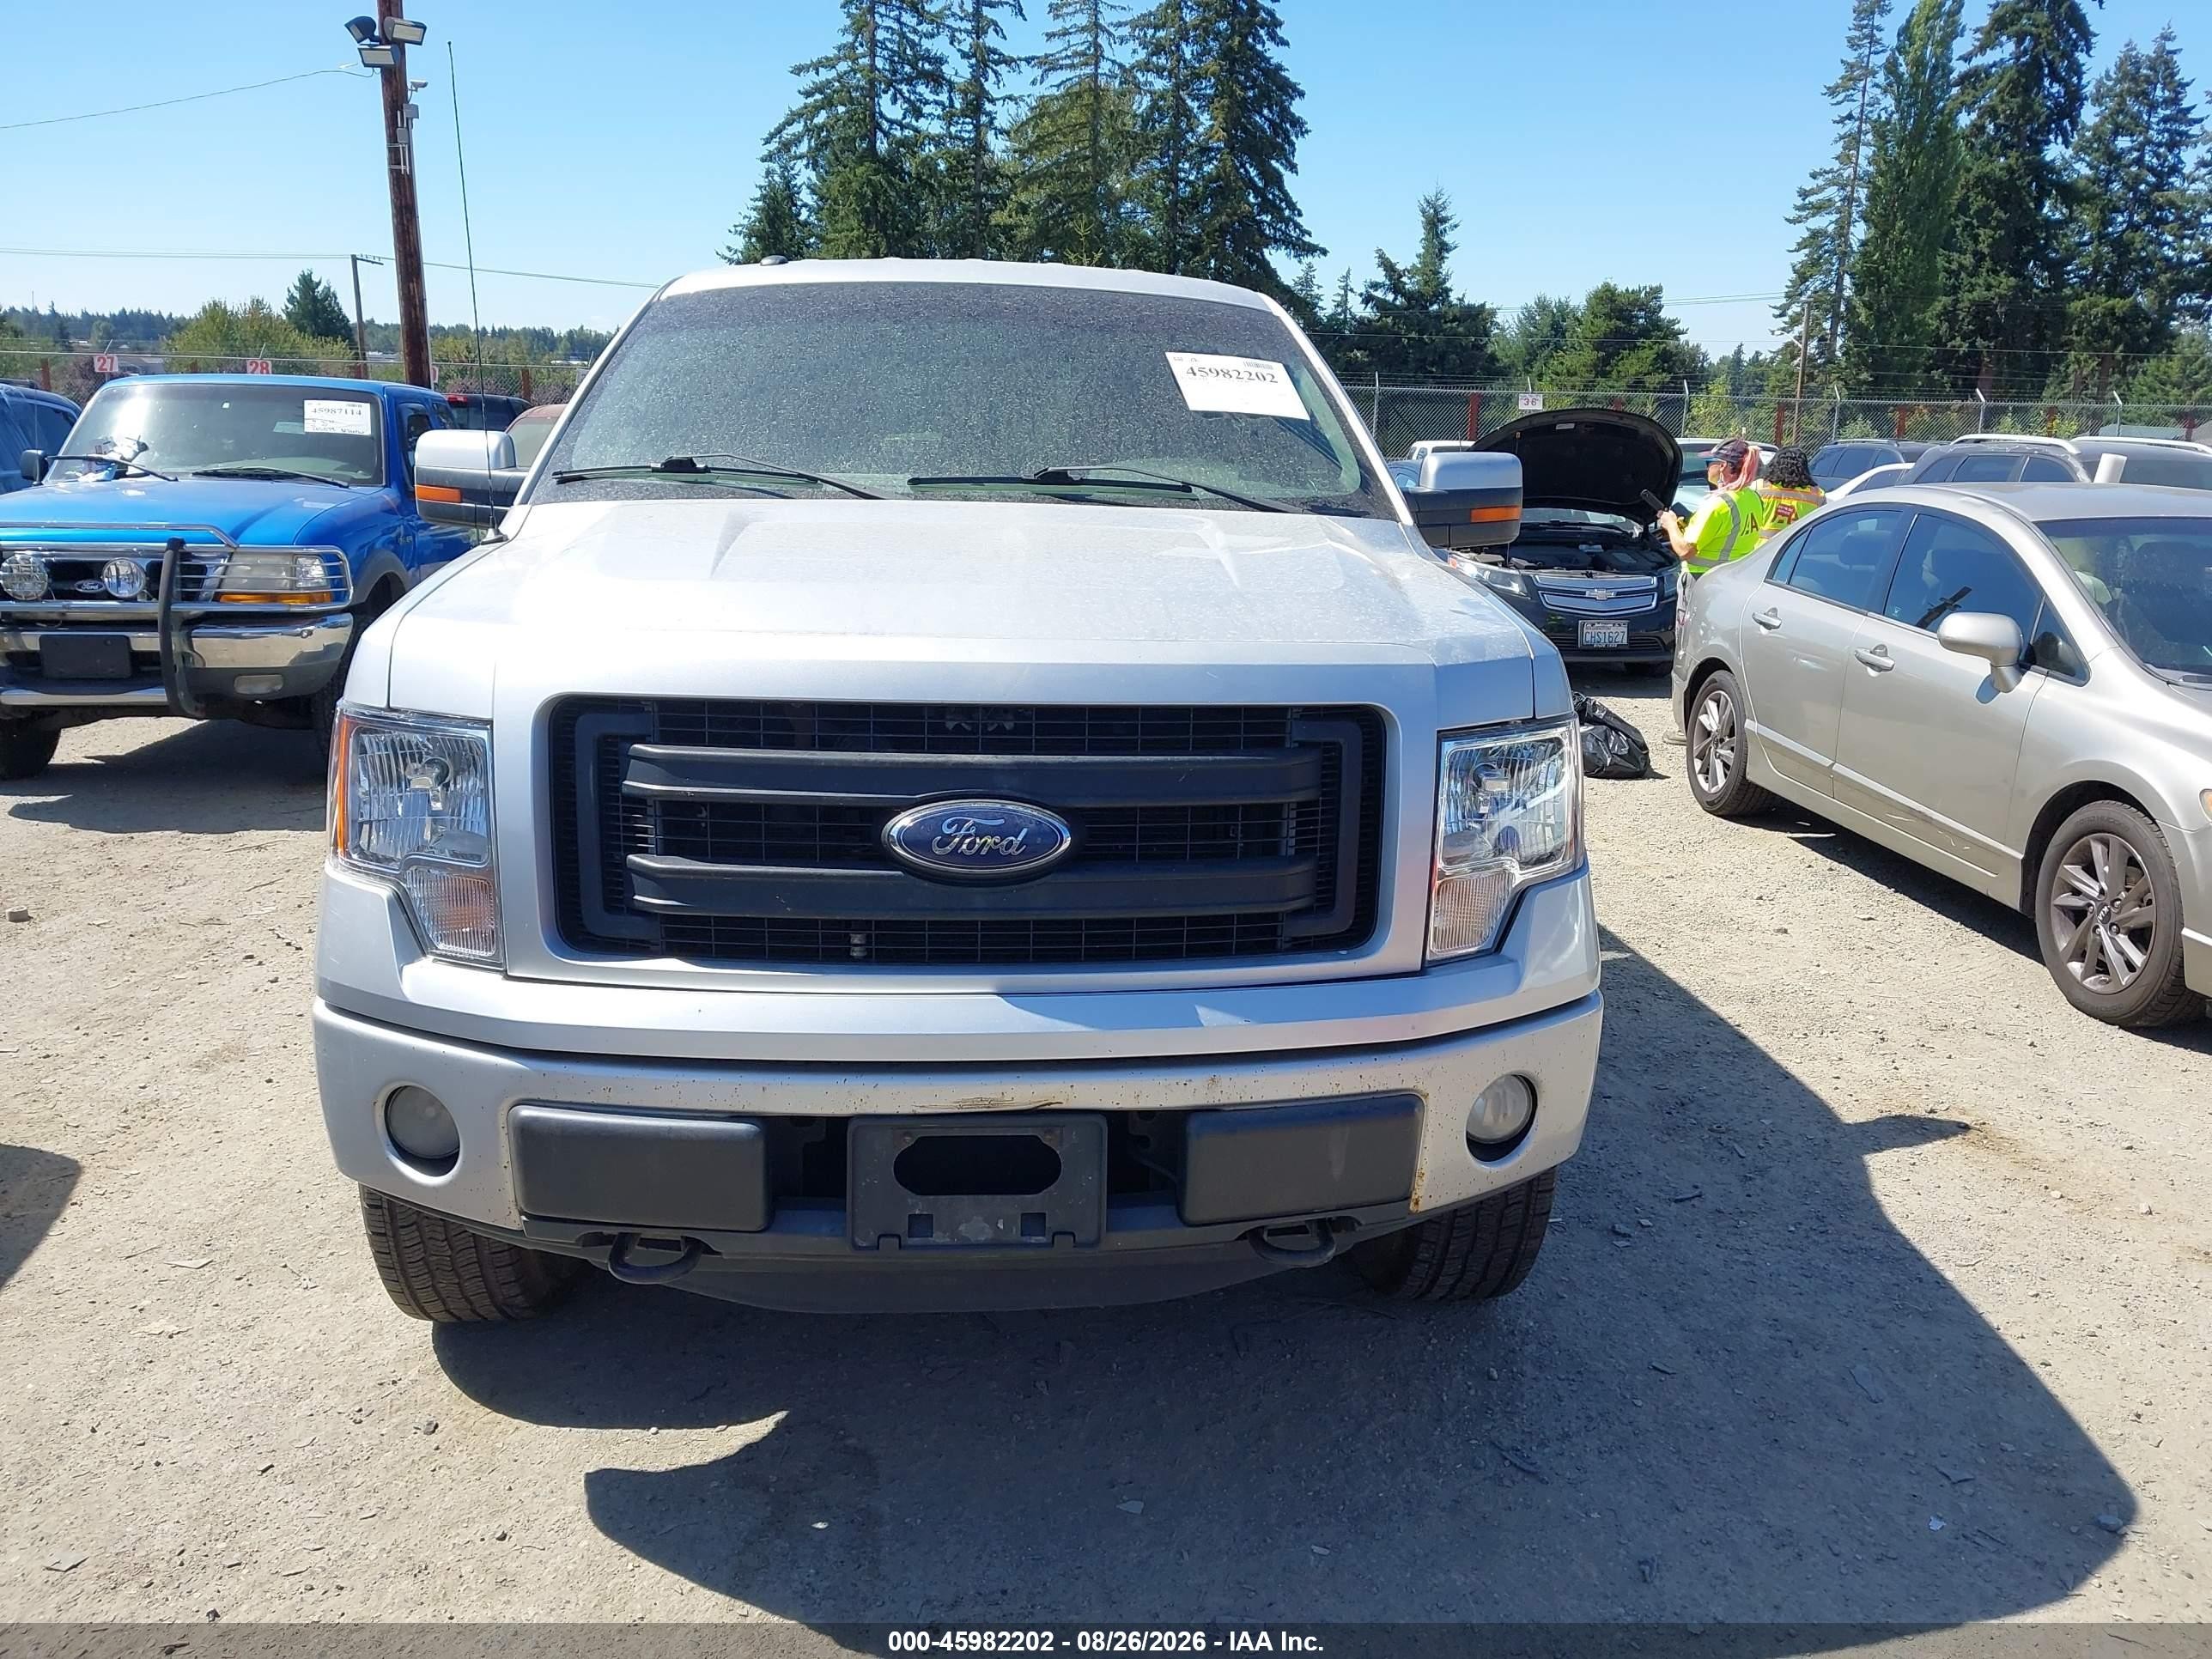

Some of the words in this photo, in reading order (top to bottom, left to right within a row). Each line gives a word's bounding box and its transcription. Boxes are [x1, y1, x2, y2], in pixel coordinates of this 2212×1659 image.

[96, 356, 114, 372] 27
[249, 361, 270, 374] 28
[1186, 366, 1279, 384] 45982202
[1584, 631, 1626, 643] CHS1627
[931, 817, 1028, 856] Ford
